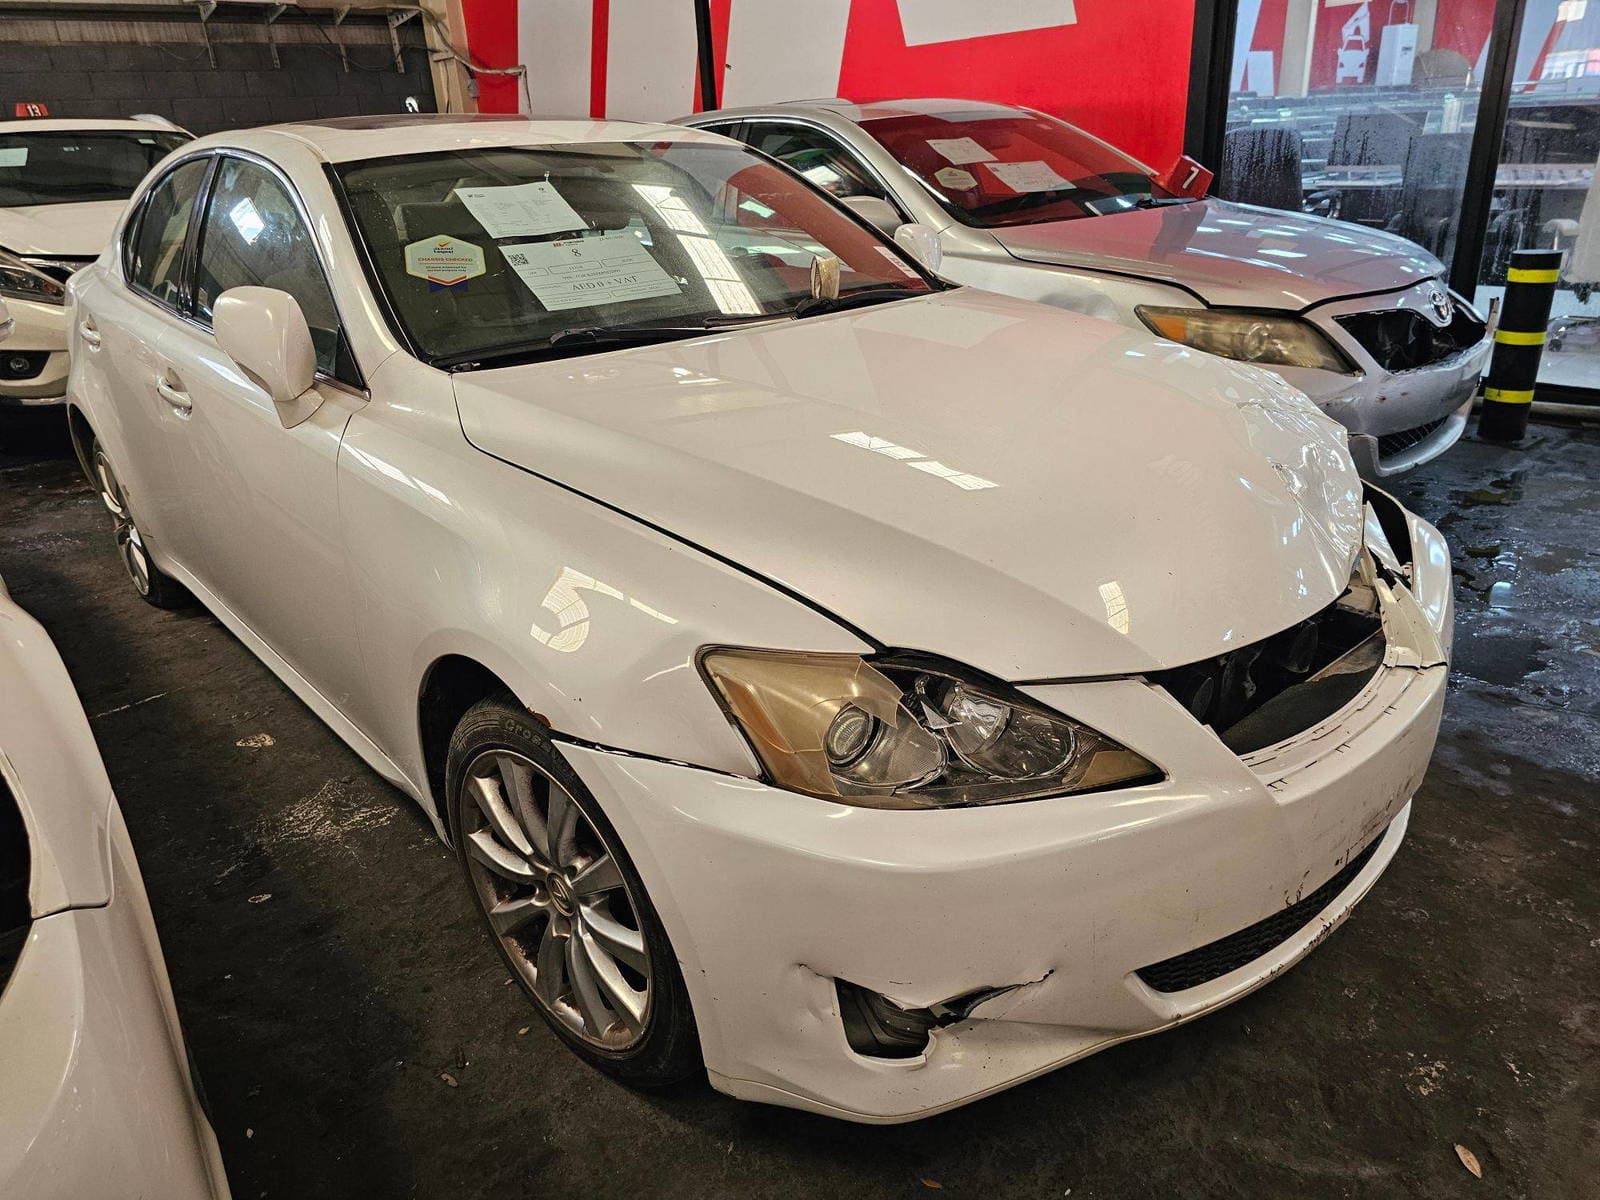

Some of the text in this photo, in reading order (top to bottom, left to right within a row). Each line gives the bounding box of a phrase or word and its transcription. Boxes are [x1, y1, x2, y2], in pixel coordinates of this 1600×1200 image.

[26, 103, 42, 117] 13
[1182, 166, 1200, 189] 7
[571, 248, 582, 257] 8
[572, 282, 596, 291] AED
[614, 275, 638, 284] VAT
